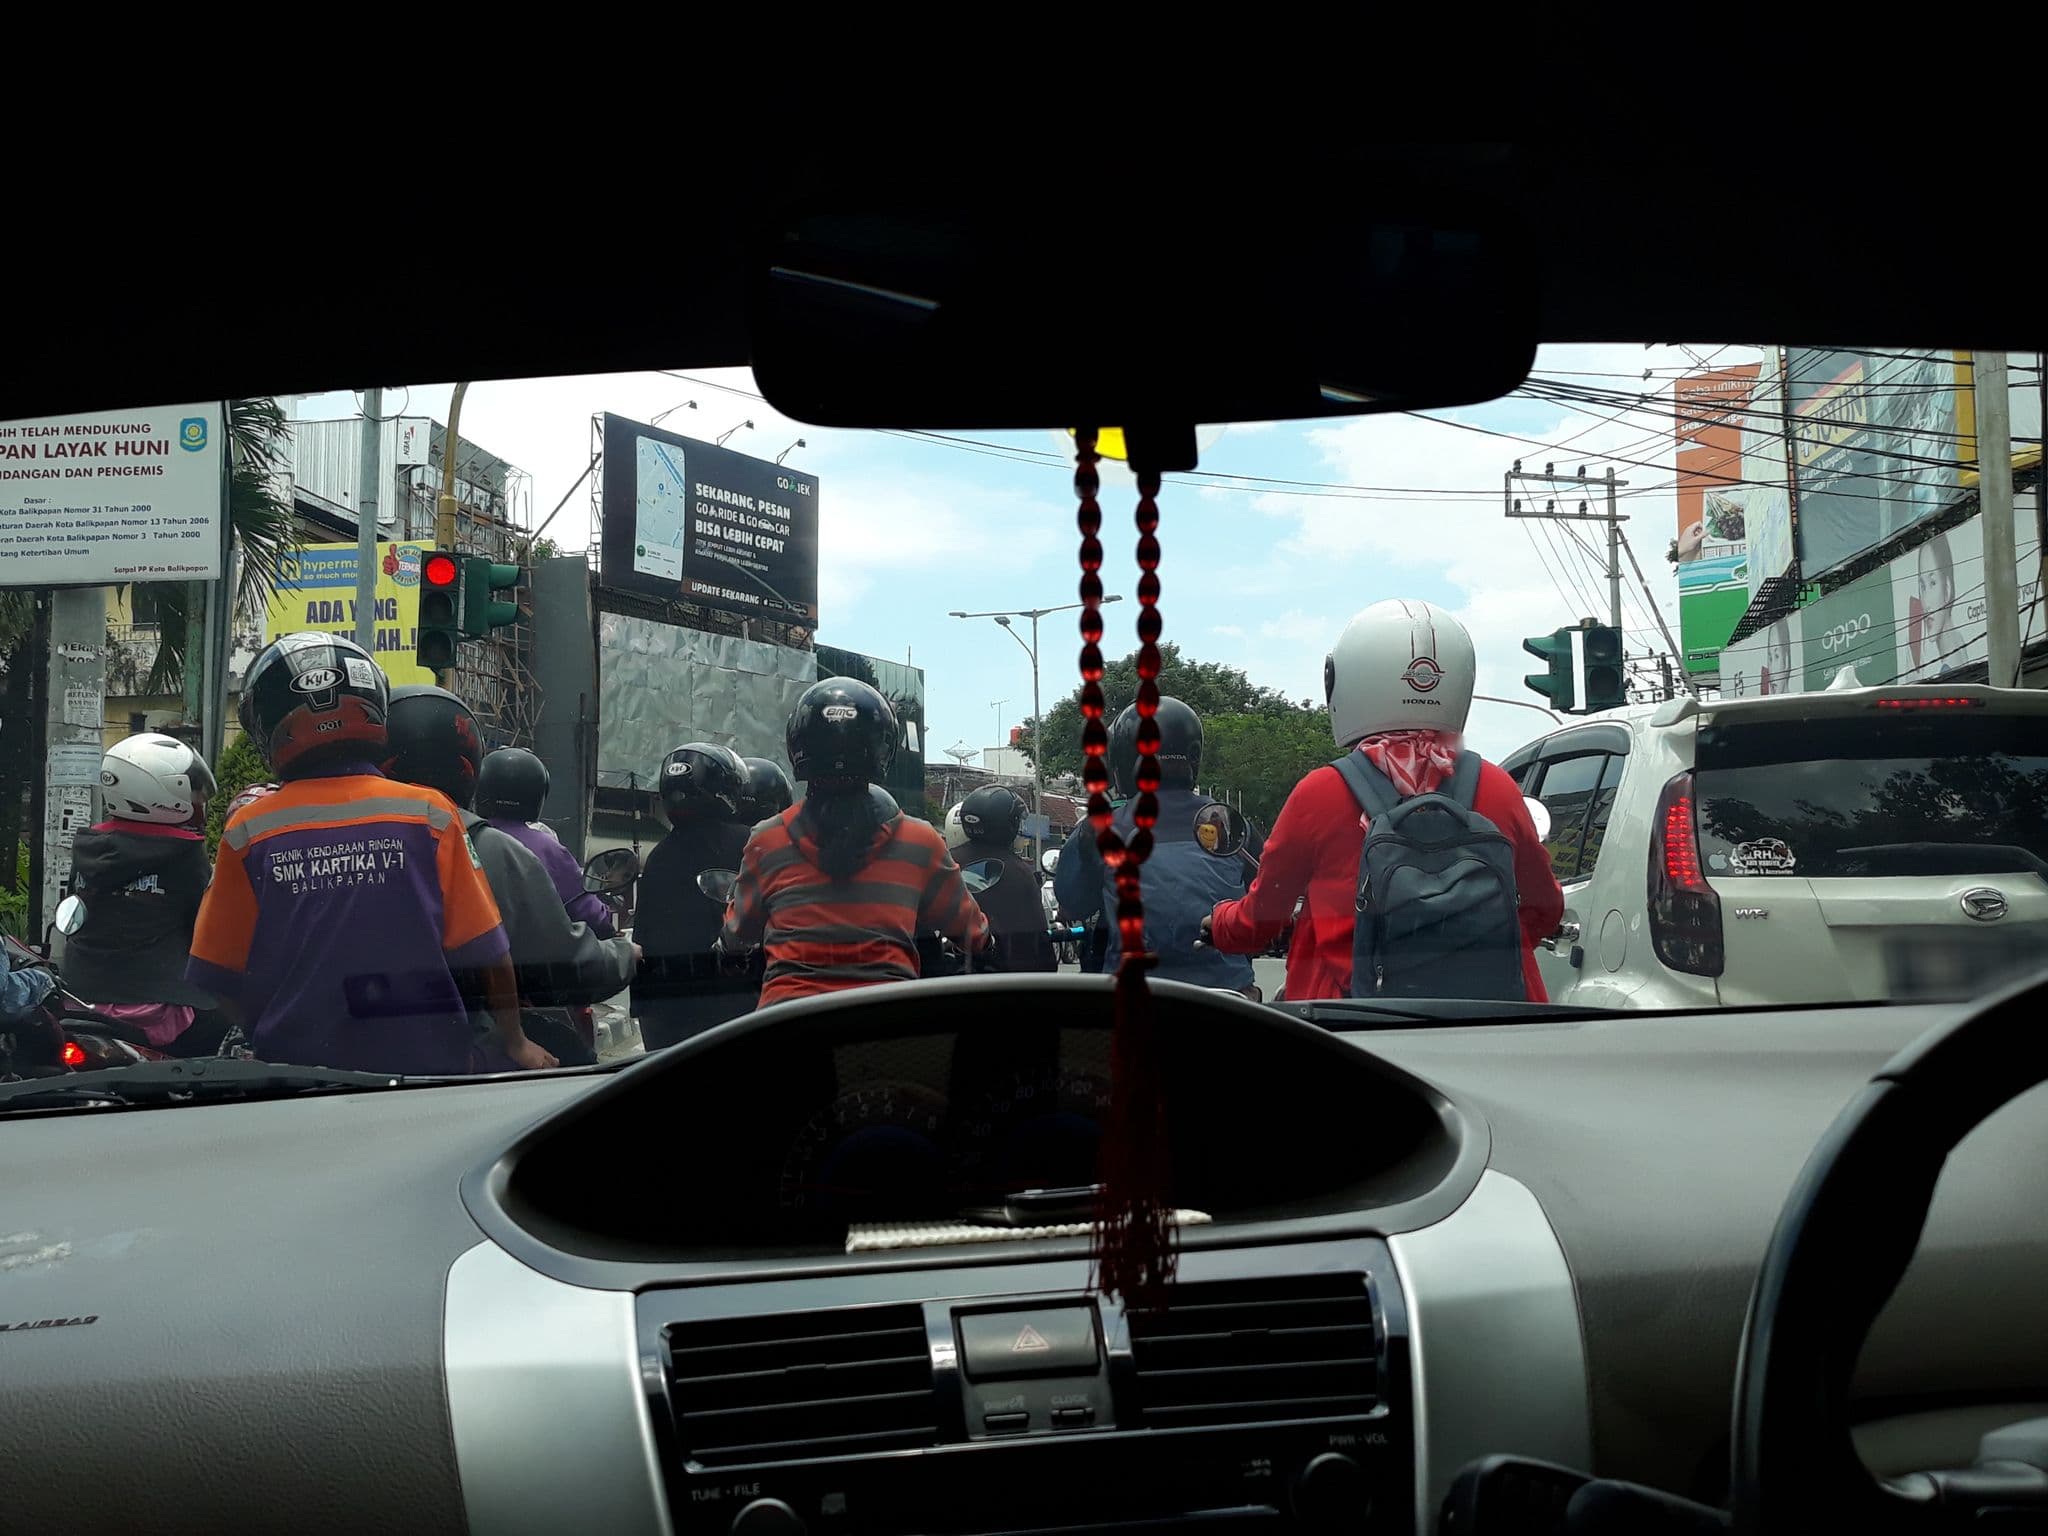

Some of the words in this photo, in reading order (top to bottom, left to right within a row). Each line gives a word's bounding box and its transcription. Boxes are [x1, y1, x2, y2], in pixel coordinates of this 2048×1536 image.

[21, 427, 60, 437] TELAH
[64, 424, 151, 436] MENDUKUNG
[44, 441, 107, 458] LAYAK
[115, 440, 170, 456] HUNI
[65, 468, 93, 478] DAN
[97, 465, 164, 477] PENGEMIS
[776, 476, 789, 490] GO
[797, 482, 811, 497] JEK
[695, 482, 757, 512] SEKARANG,
[758, 499, 791, 520] PESAN
[19, 508, 62, 516] Balikpapan
[93, 506, 102, 514] 31
[131, 504, 152, 512] 2000
[26, 522, 53, 530] Daerah
[55, 520, 74, 528] Kota
[75, 519, 119, 528] Balikpapan
[121, 518, 148, 526] Nomor
[150, 518, 161, 526] 13
[163, 517, 187, 525] Tahun
[190, 517, 210, 525] 2006
[695, 501, 709, 516] GO
[717, 507, 738, 522] RIDE
[738, 512, 746, 525] &
[746, 514, 758, 528] GO
[775, 522, 790, 537] CAR
[16, 535, 45, 543] Daerah
[47, 534, 65, 542] Kota
[67, 533, 110, 543] Balikpapan
[112, 532, 139, 540] Nomor
[140, 532, 147, 540] 3
[153, 531, 179, 539] Tahun
[181, 530, 201, 538] 2000
[695, 519, 721, 538] BISA
[723, 526, 753, 546] LEBIH
[754, 534, 785, 554] CEPAT
[21, 549, 63, 557] Ketertiban
[64, 548, 90, 556] Umum
[168, 564, 209, 573] Balikpapan
[317, 571, 340, 579] much
[691, 581, 721, 597] UPDATE
[721, 587, 760, 605] SEKARANG
[306, 600, 345, 624] ADA
[1402, 698, 1441, 706] HONDA
[318, 720, 342, 731] DOT
[270, 849, 304, 865] TEKNIK
[307, 841, 365, 858] KENDARAAN
[368, 838, 404, 851] RINGAN
[1753, 849, 1773, 860] RH
[272, 861, 306, 882] SMK
[311, 852, 376, 877] KARTIKA
[292, 871, 386, 894] BALIKPAPAN
